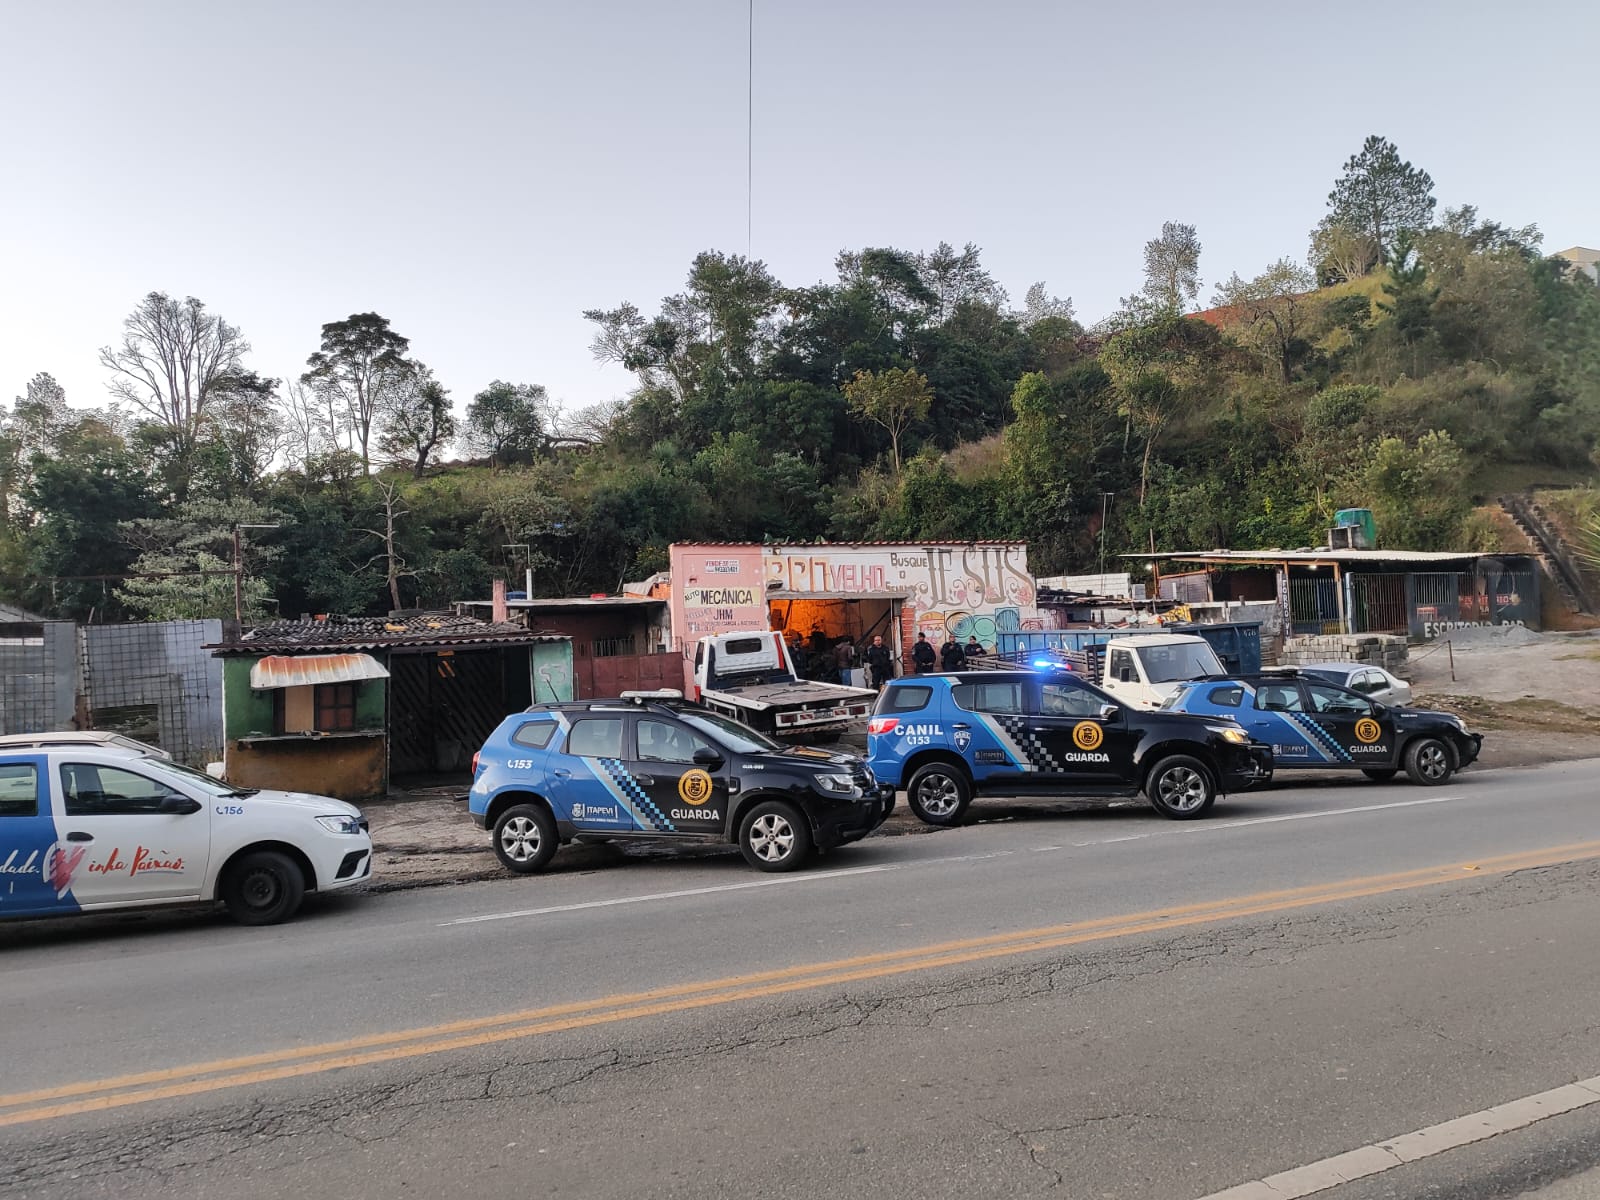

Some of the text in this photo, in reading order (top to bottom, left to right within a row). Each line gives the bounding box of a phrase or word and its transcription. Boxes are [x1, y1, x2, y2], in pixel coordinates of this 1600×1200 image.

[890, 552, 928, 567] BUSQUE
[684, 590, 699, 601] AUTO
[713, 609, 733, 620] JHM
[894, 724, 944, 736] CANIL
[913, 736, 930, 745] 153
[1349, 745, 1388, 753] GUARDA
[1065, 752, 1110, 762] GUARDA
[514, 759, 533, 769] 153
[224, 806, 244, 815] 156
[586, 806, 614, 814] ITAPEVI
[670, 808, 720, 821] GUARDA
